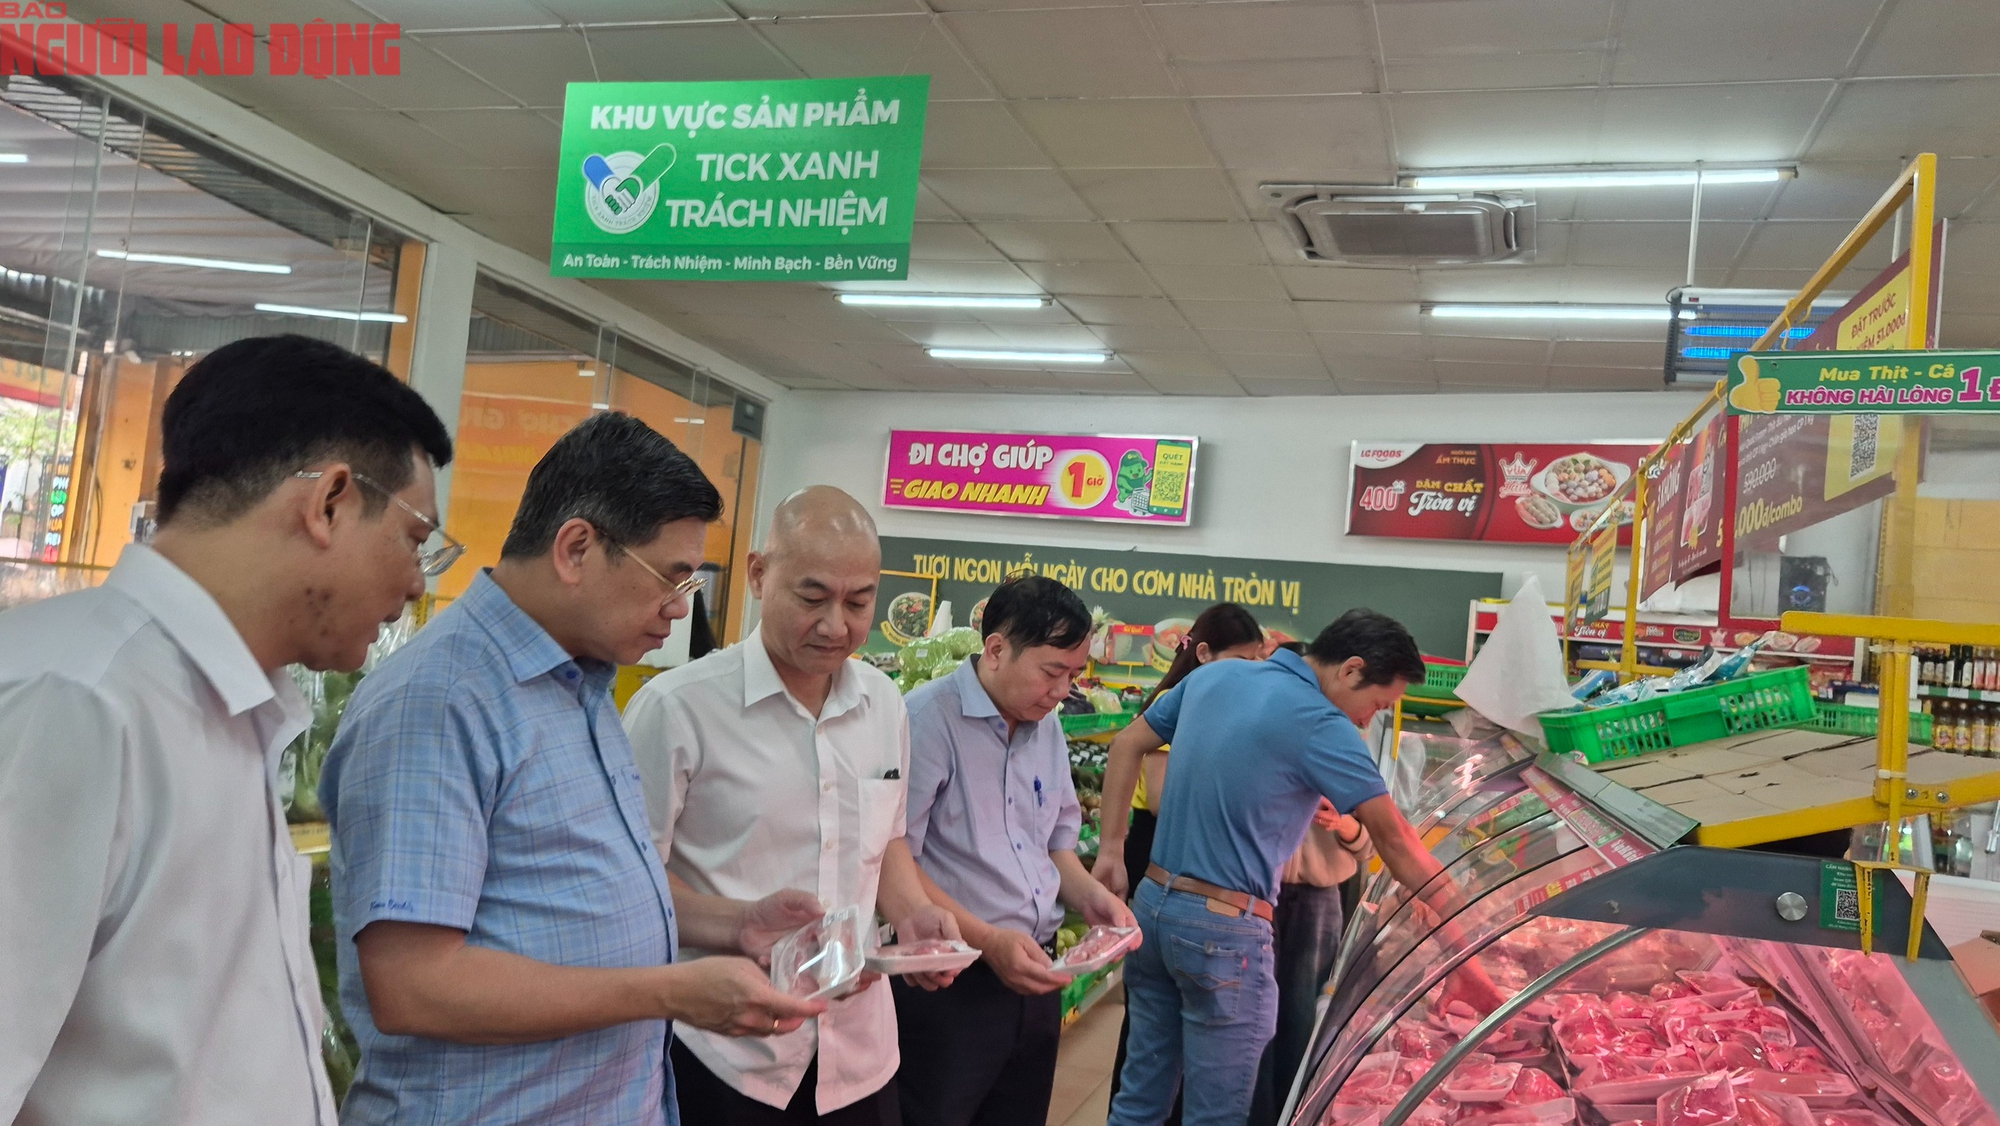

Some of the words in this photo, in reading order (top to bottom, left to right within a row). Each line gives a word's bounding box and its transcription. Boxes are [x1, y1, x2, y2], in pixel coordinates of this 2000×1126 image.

[590, 104, 657, 130] KHU
[663, 101, 728, 138] VỰC
[731, 95, 798, 130] SẢN
[803, 88, 900, 127] PHẨM
[696, 152, 769, 182] TICK
[776, 150, 879, 181] XANH
[665, 192, 776, 228] TRÁCH
[777, 189, 888, 235] NHIỆM
[563, 253, 584, 268] An
[631, 254, 671, 269] Trách
[674, 255, 722, 273] Nhiệm
[734, 256, 772, 270] Minh
[774, 255, 812, 274] Bạch
[824, 253, 854, 271] Bền
[857, 255, 898, 272] Vững
[1785, 386, 1854, 405] KHÔNG
[1858, 385, 1895, 405] HÀI
[1898, 384, 1953, 404] LÒNG
[1957, 366, 1984, 402] 1
[1819, 367, 1861, 382] Mua
[1868, 365, 1908, 383] Thịt
[1928, 363, 1955, 379] Cá
[909, 442, 934, 465] ĐI
[937, 442, 988, 475] CHỢ
[992, 440, 1054, 471] GIÚP
[1452, 457, 1476, 466] THỰC
[904, 479, 959, 500] GIAO
[959, 482, 1050, 506] NHANH
[1067, 461, 1086, 498] 1
[1444, 478, 1484, 494] CHẤT
[1359, 486, 1398, 511] 400
[1408, 490, 1454, 517] Tròn
[1457, 495, 1478, 517] vị
[913, 554, 950, 580] TƯƠI
[953, 557, 1001, 584] NGON
[1043, 559, 1087, 590] NGÀY
[1091, 567, 1128, 593] CHO
[1133, 569, 1175, 597] CƠM
[1178, 569, 1216, 601] NHÀ
[1222, 571, 1276, 605] TRÒN
[1280, 580, 1301, 615] VỊ
